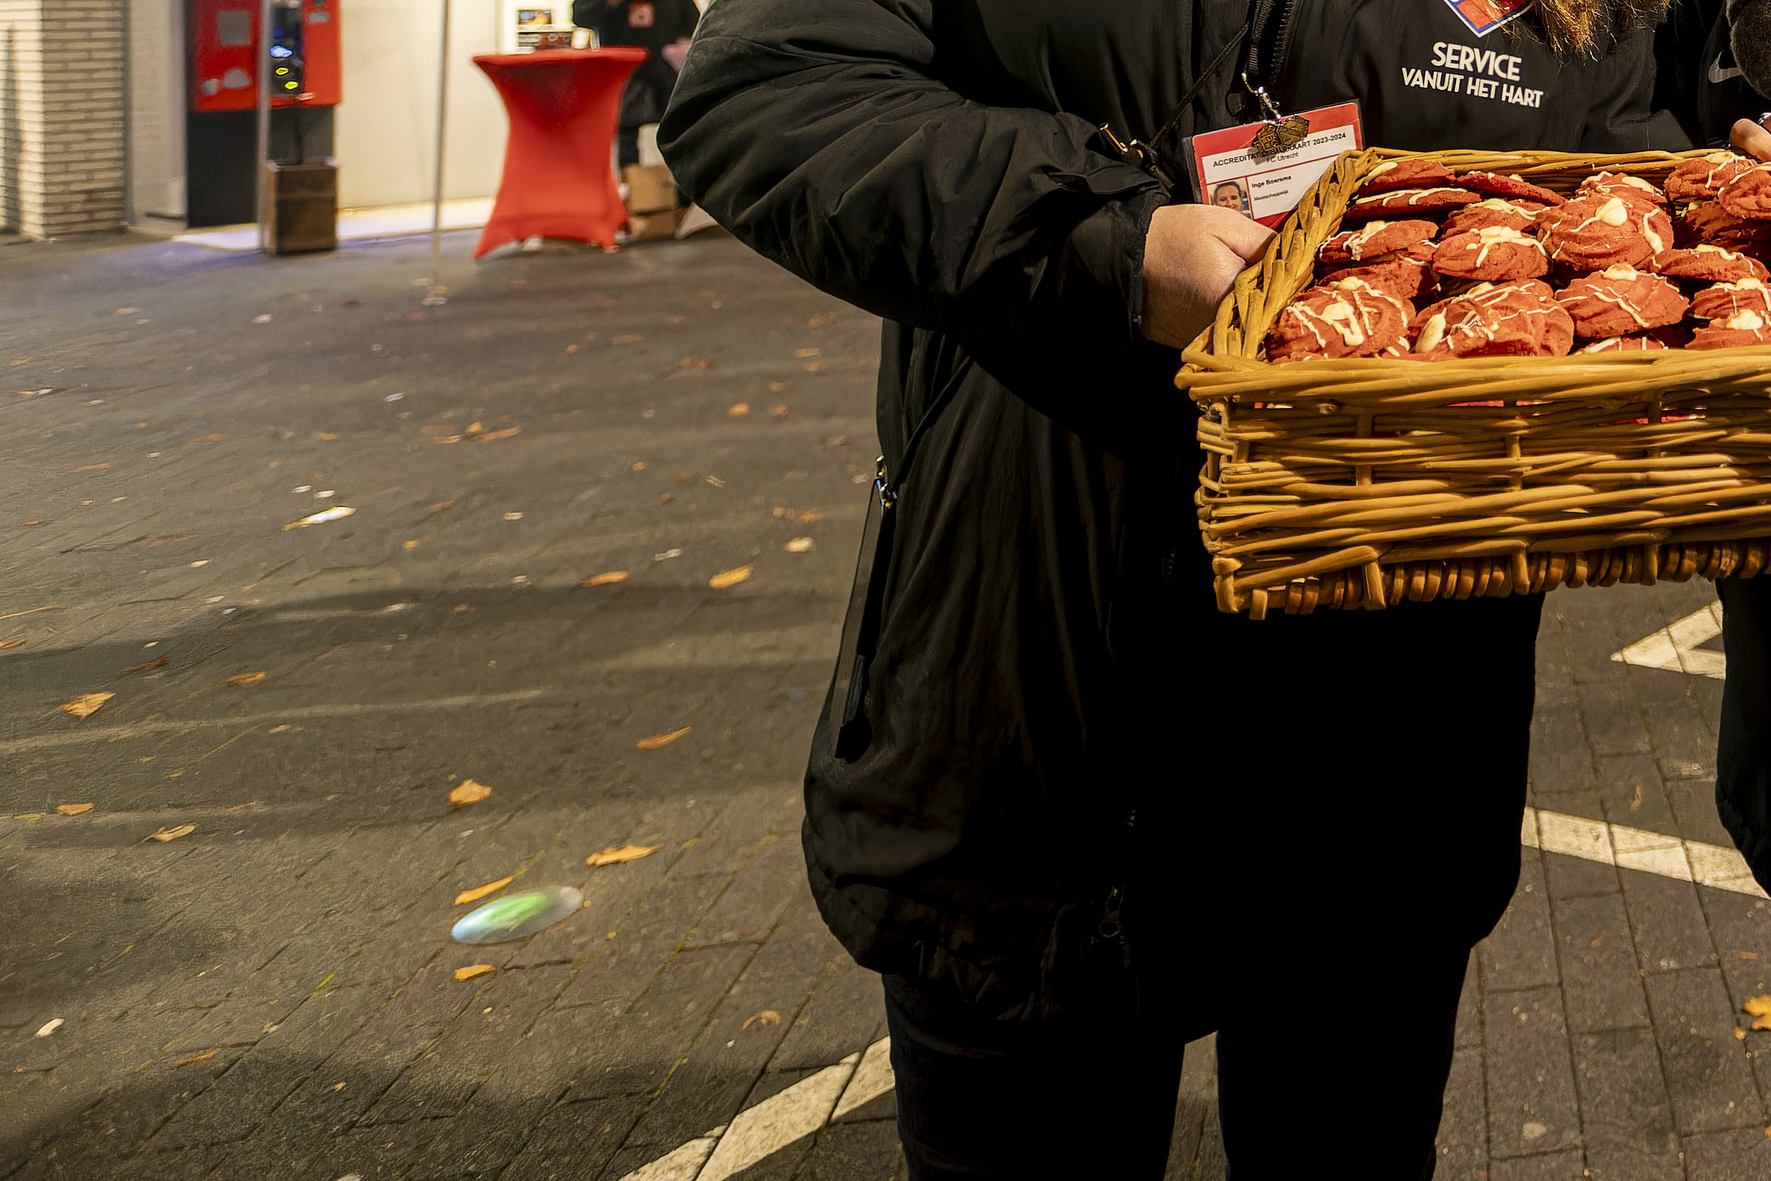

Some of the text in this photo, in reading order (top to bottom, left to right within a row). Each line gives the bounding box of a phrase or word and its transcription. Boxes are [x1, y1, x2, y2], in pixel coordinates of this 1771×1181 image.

[1431, 42, 1523, 81] SERVICE
[1402, 68, 1544, 108] VANUIT HET HART
[1312, 132, 1347, 146] 2023-2024
[1277, 151, 1299, 162] Utrecht
[1251, 175, 1292, 189] Inge Boersma
